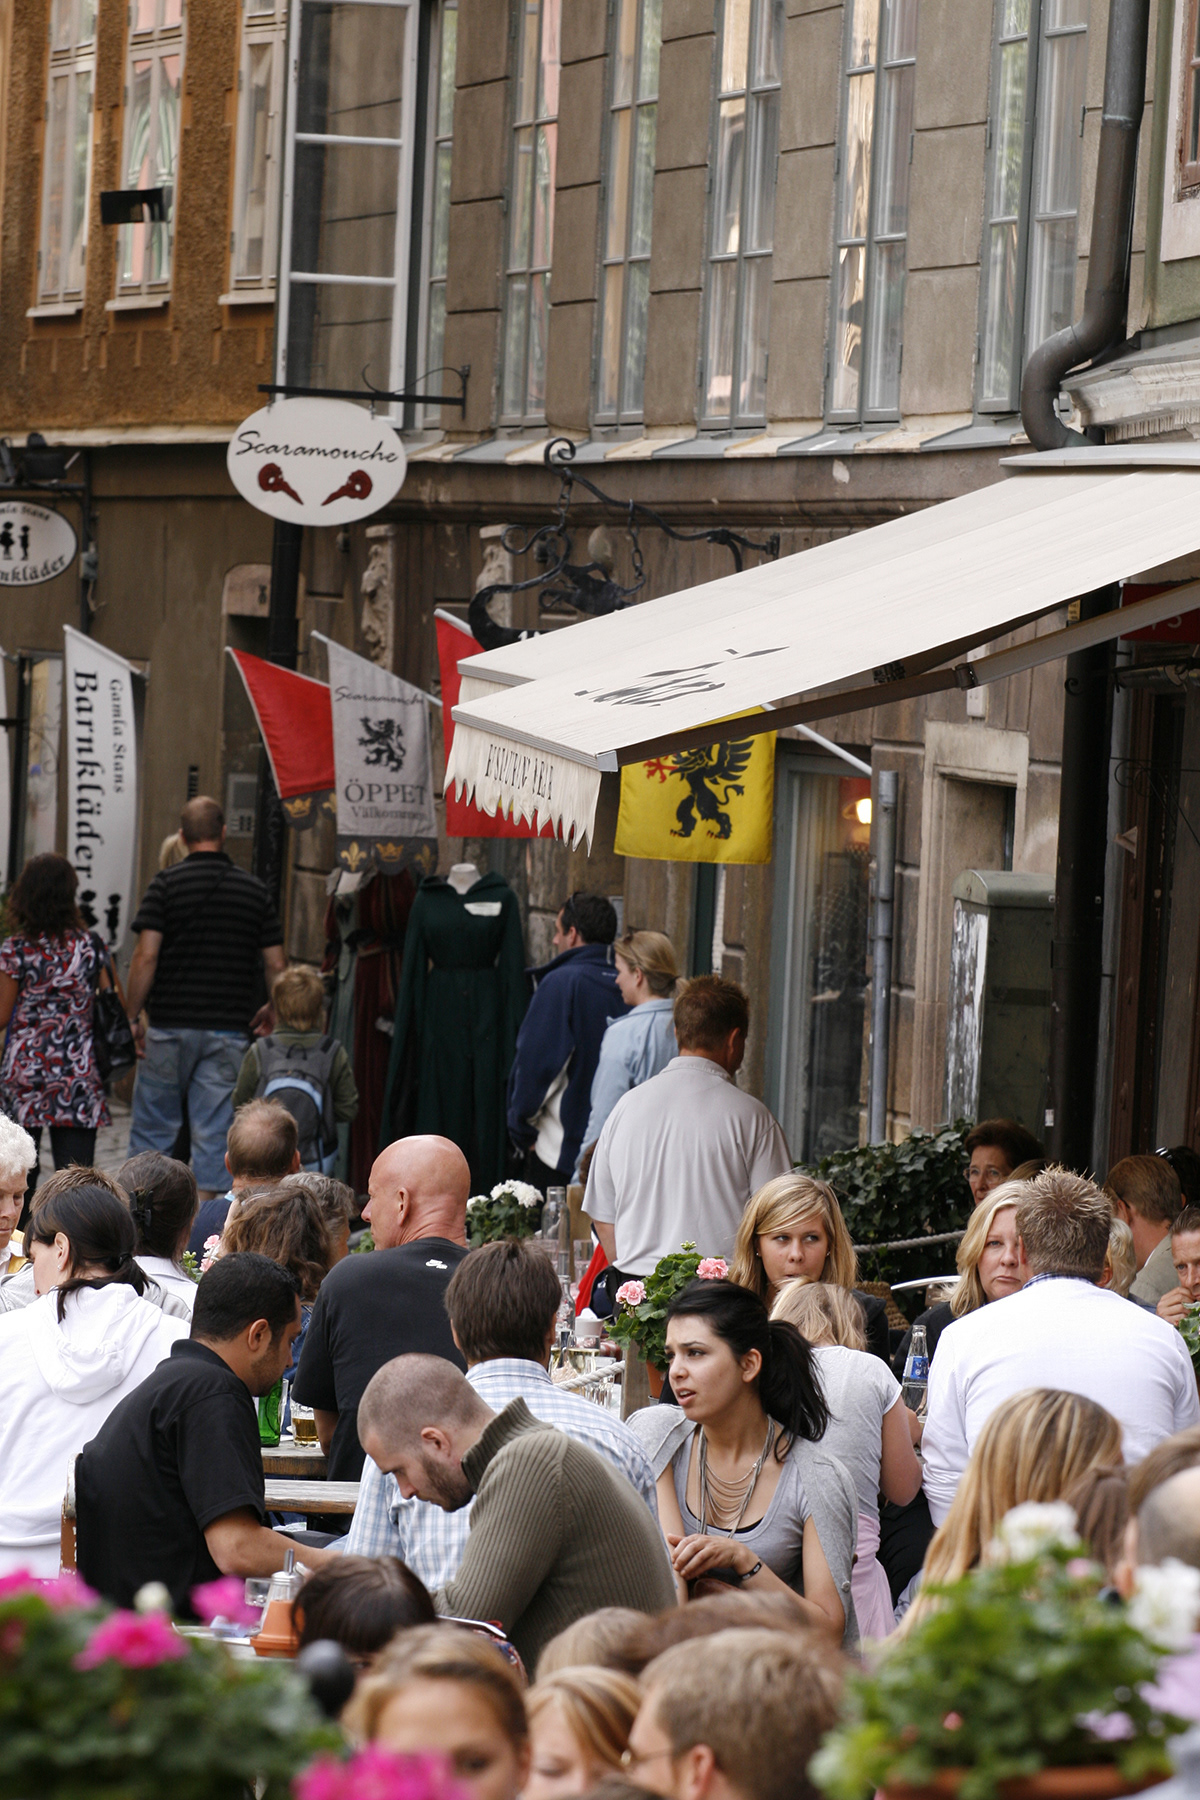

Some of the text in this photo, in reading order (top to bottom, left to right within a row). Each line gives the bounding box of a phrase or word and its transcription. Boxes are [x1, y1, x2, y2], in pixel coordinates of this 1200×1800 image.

[235, 430, 399, 464] Scaramouche
[108, 678, 128, 794] Gamla Stans
[73, 669, 106, 880] Barnkläder
[344, 778, 427, 806] ÖPPET
